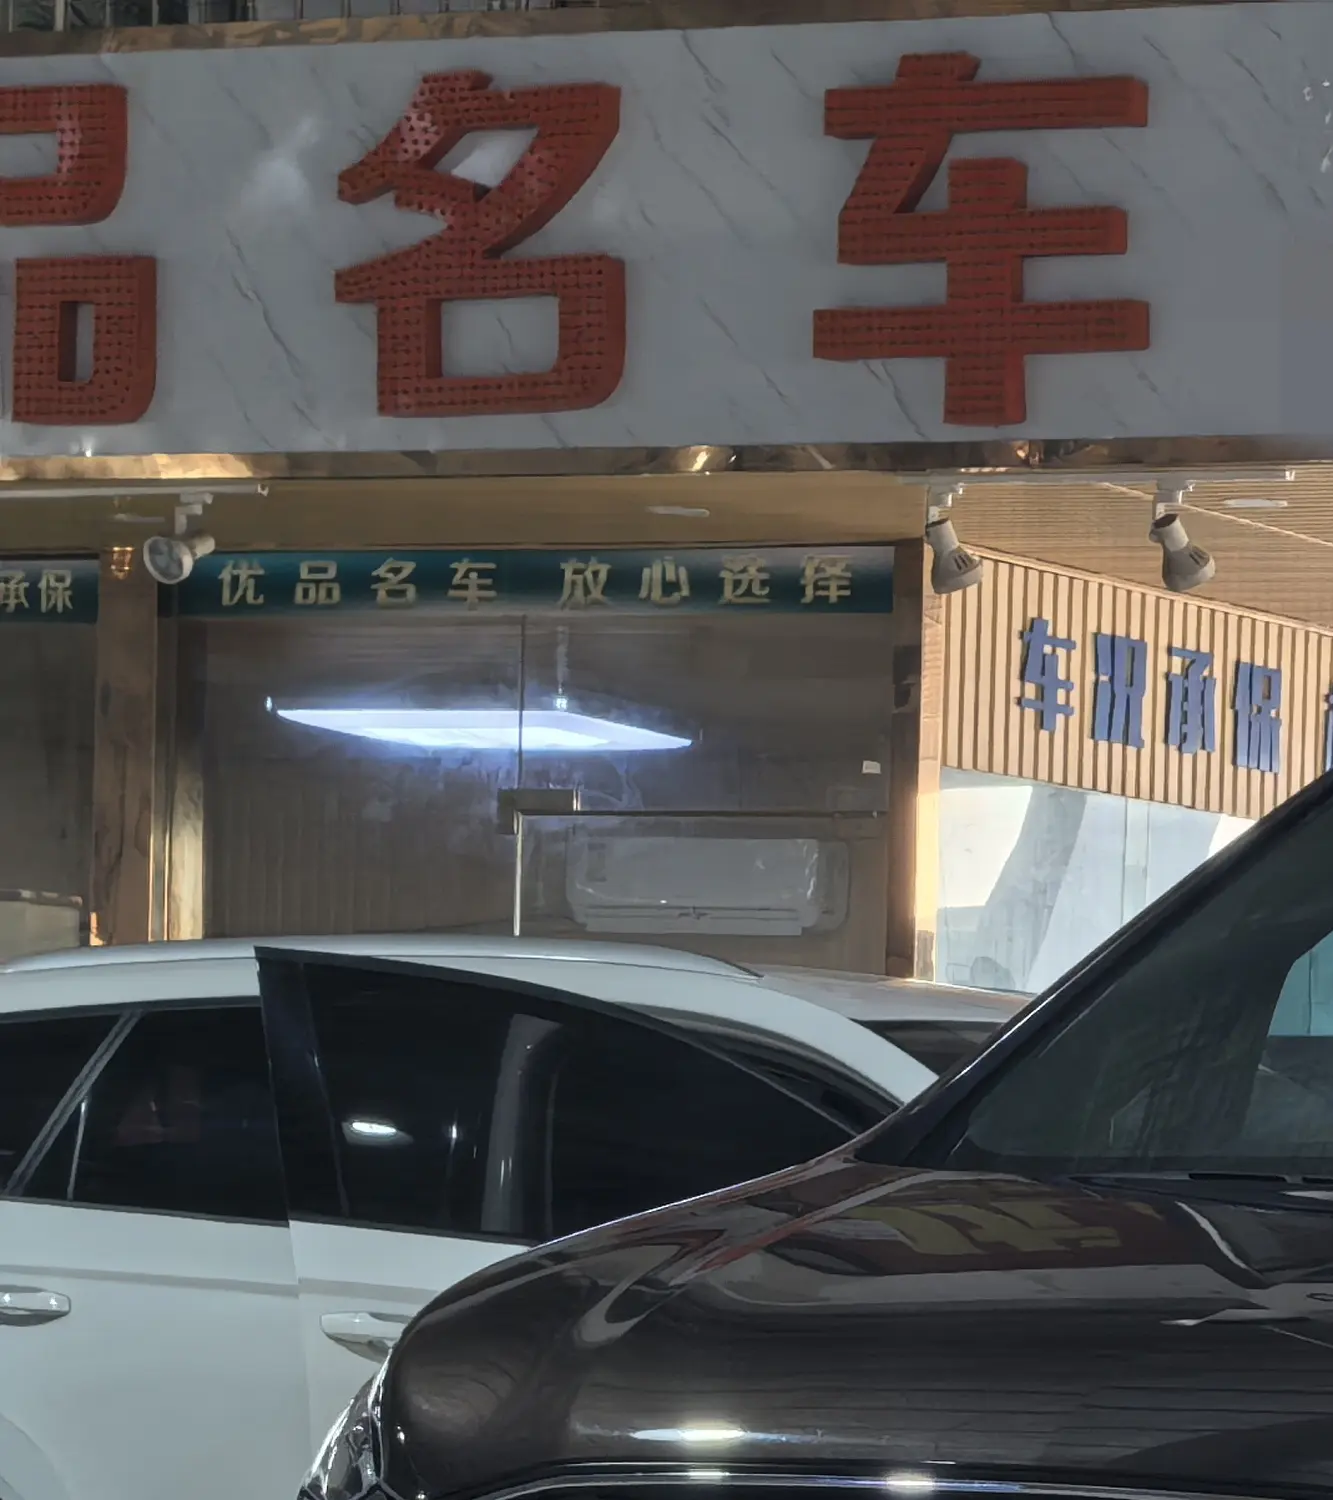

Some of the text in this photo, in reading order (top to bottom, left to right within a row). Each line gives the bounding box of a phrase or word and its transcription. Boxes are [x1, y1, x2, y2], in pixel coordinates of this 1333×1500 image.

[218, 553, 853, 611] 优品名车 放心选择
[1017, 616, 1282, 773] 车况承保
